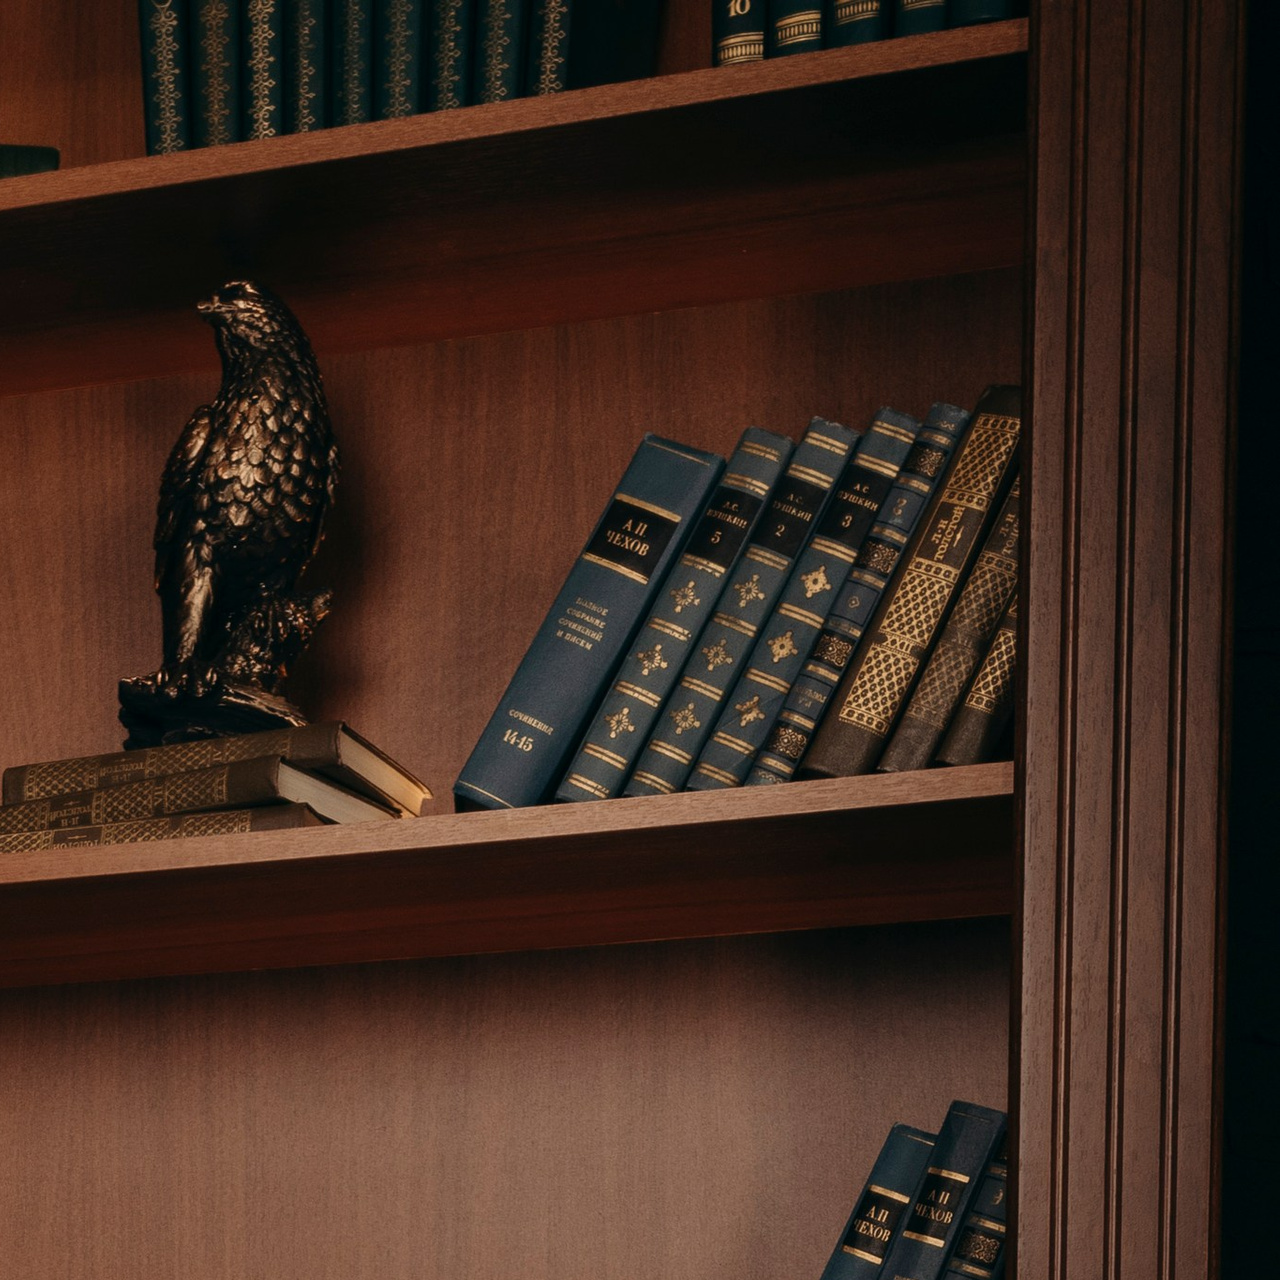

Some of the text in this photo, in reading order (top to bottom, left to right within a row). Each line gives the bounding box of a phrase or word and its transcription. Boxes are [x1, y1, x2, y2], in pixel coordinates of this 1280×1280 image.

[706, 508, 749, 530] ПУШКИН
[841, 514, 853, 529] 3
[710, 530, 723, 545] 5
[774, 524, 786, 538] 2
[934, 504, 966, 563] ТОЛСТОЙ
[607, 529, 651, 557] ЧЕХОВ
[566, 607, 607, 630] СОБРАНИЕ
[575, 597, 609, 617] ПОЛНОЕ
[556, 629, 594, 651] И ПИСЕМ
[558, 617, 604, 643] СОЧИНЕНИЙ
[509, 709, 555, 736] СОЧИНЕНИЯ
[503, 729, 535, 752] 14-15
[915, 1202, 955, 1225] ЧЕХОВ
[854, 1218, 893, 1243] ЧЕХОВ
